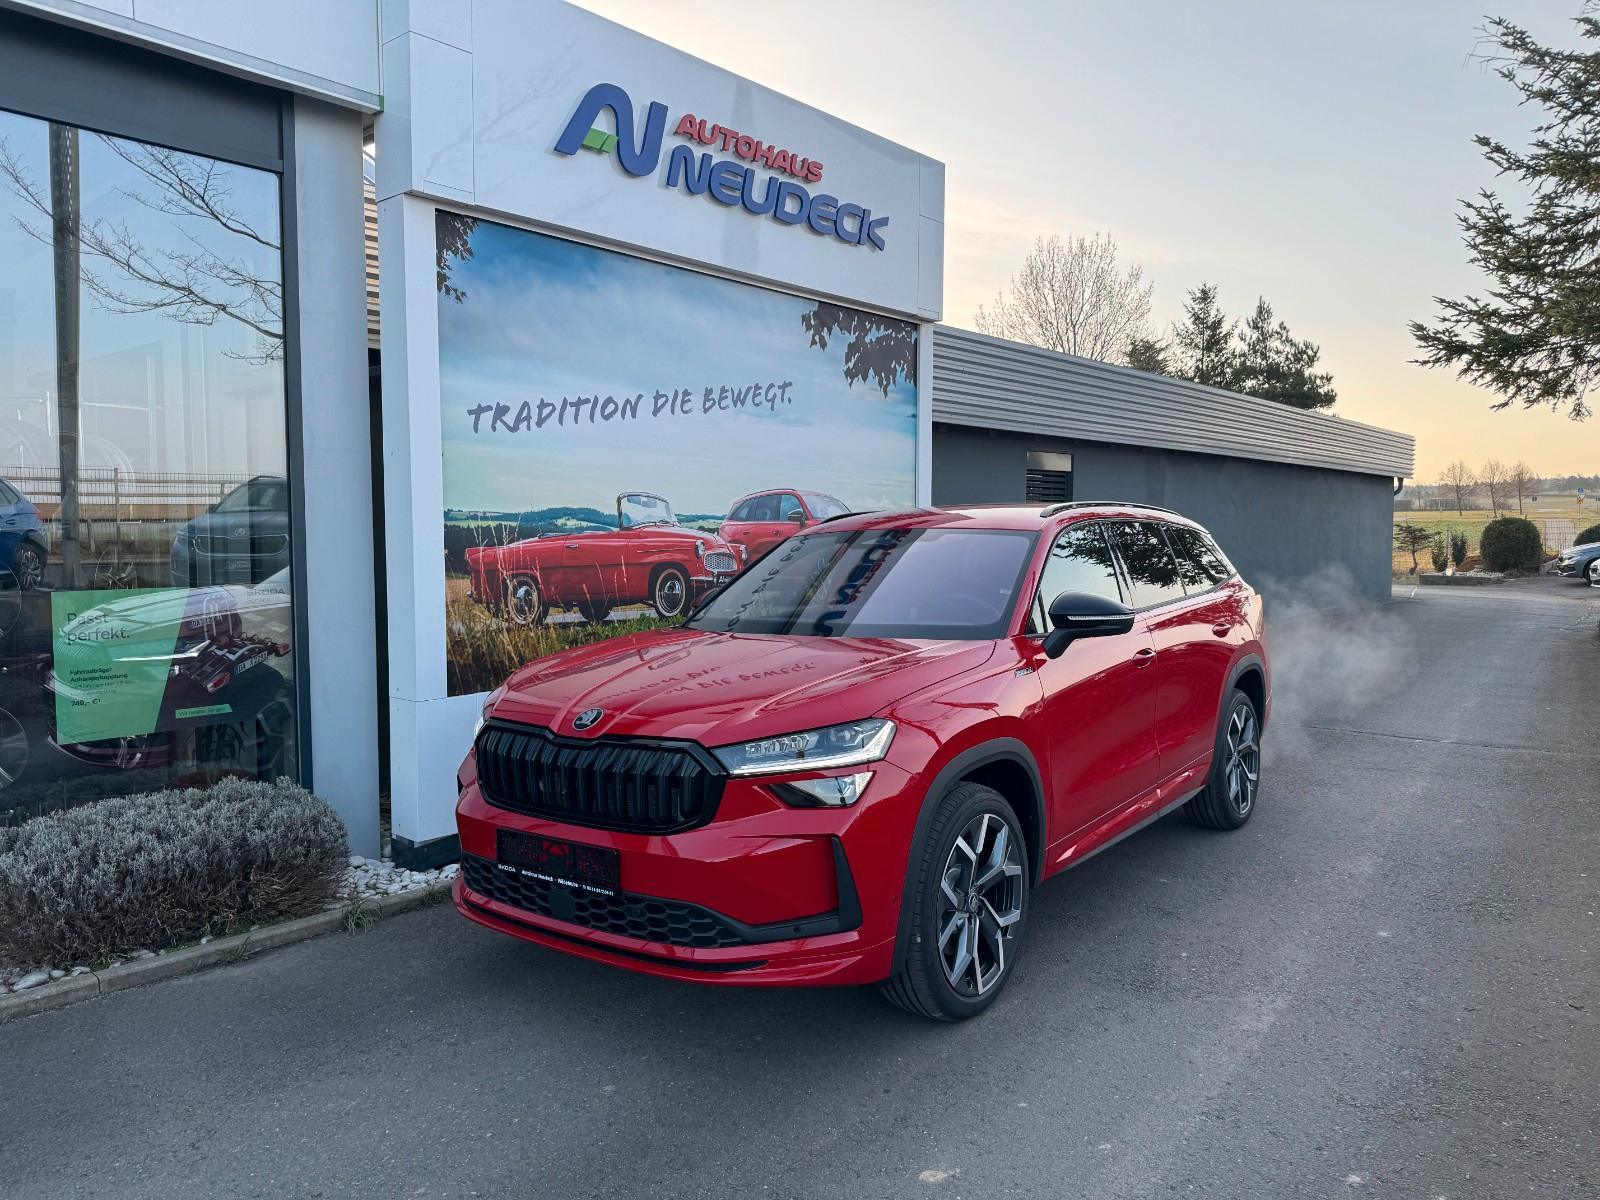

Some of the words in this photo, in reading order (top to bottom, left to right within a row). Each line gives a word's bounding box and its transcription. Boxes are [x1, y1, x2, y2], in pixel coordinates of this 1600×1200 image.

[675, 113, 823, 183] AUTOHAUS
[667, 144, 889, 251] NEUDECK
[466, 393, 644, 434] TRADITION
[652, 388, 694, 417] DIE
[701, 380, 793, 415] BEWEGT.
[67, 612, 110, 624] Passt
[67, 627, 130, 646] perfekt.
